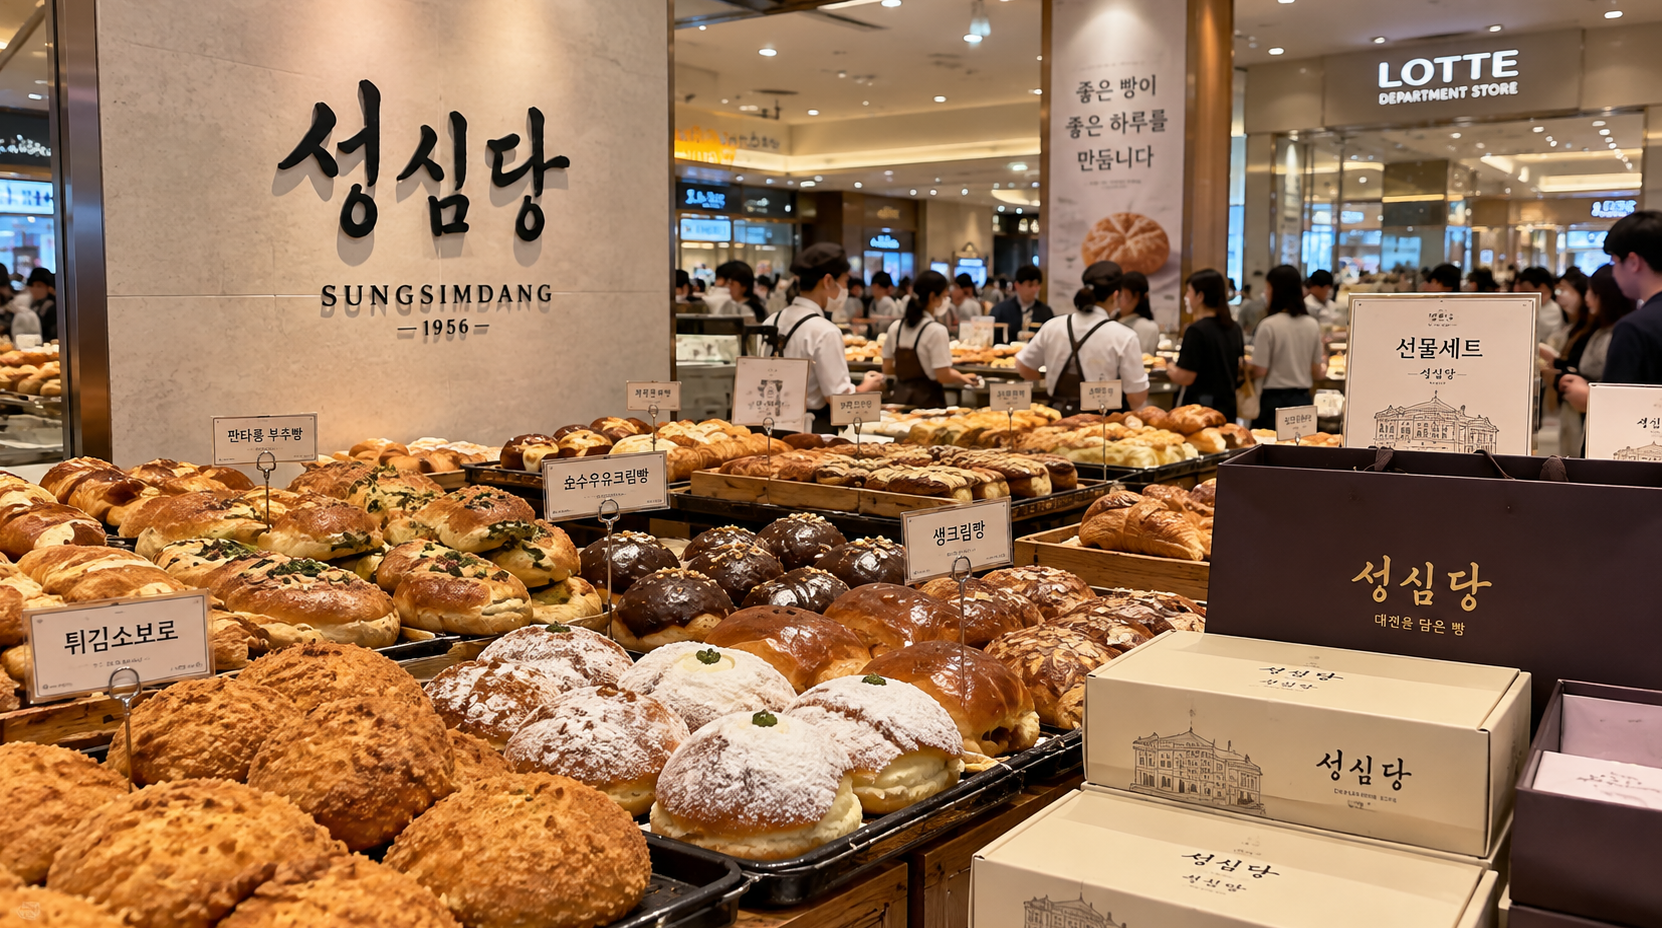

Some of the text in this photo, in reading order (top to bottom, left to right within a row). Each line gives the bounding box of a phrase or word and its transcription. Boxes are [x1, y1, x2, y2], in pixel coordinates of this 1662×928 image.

[1378, 49, 1519, 88] LOTTE
[1076, 74, 1156, 103] 좋은 빵이
[1378, 82, 1518, 105] DEPARTMENT STORE
[1066, 109, 1167, 139] 좋은 하루를
[277, 79, 570, 243] 성심당
[322, 284, 551, 306] SUNGSIMDANG
[424, 319, 468, 336] 1956
[1396, 337, 1482, 359] 선물세트
[268, 428, 303, 441] 부추빵
[1352, 555, 1492, 611] 성심당
[65, 621, 178, 654] 튀김소보로
[1420, 619, 1445, 634] 담은
[1452, 623, 1465, 635] 빵
[1316, 749, 1412, 791] 성심당
[1181, 853, 1280, 879] 성심당
